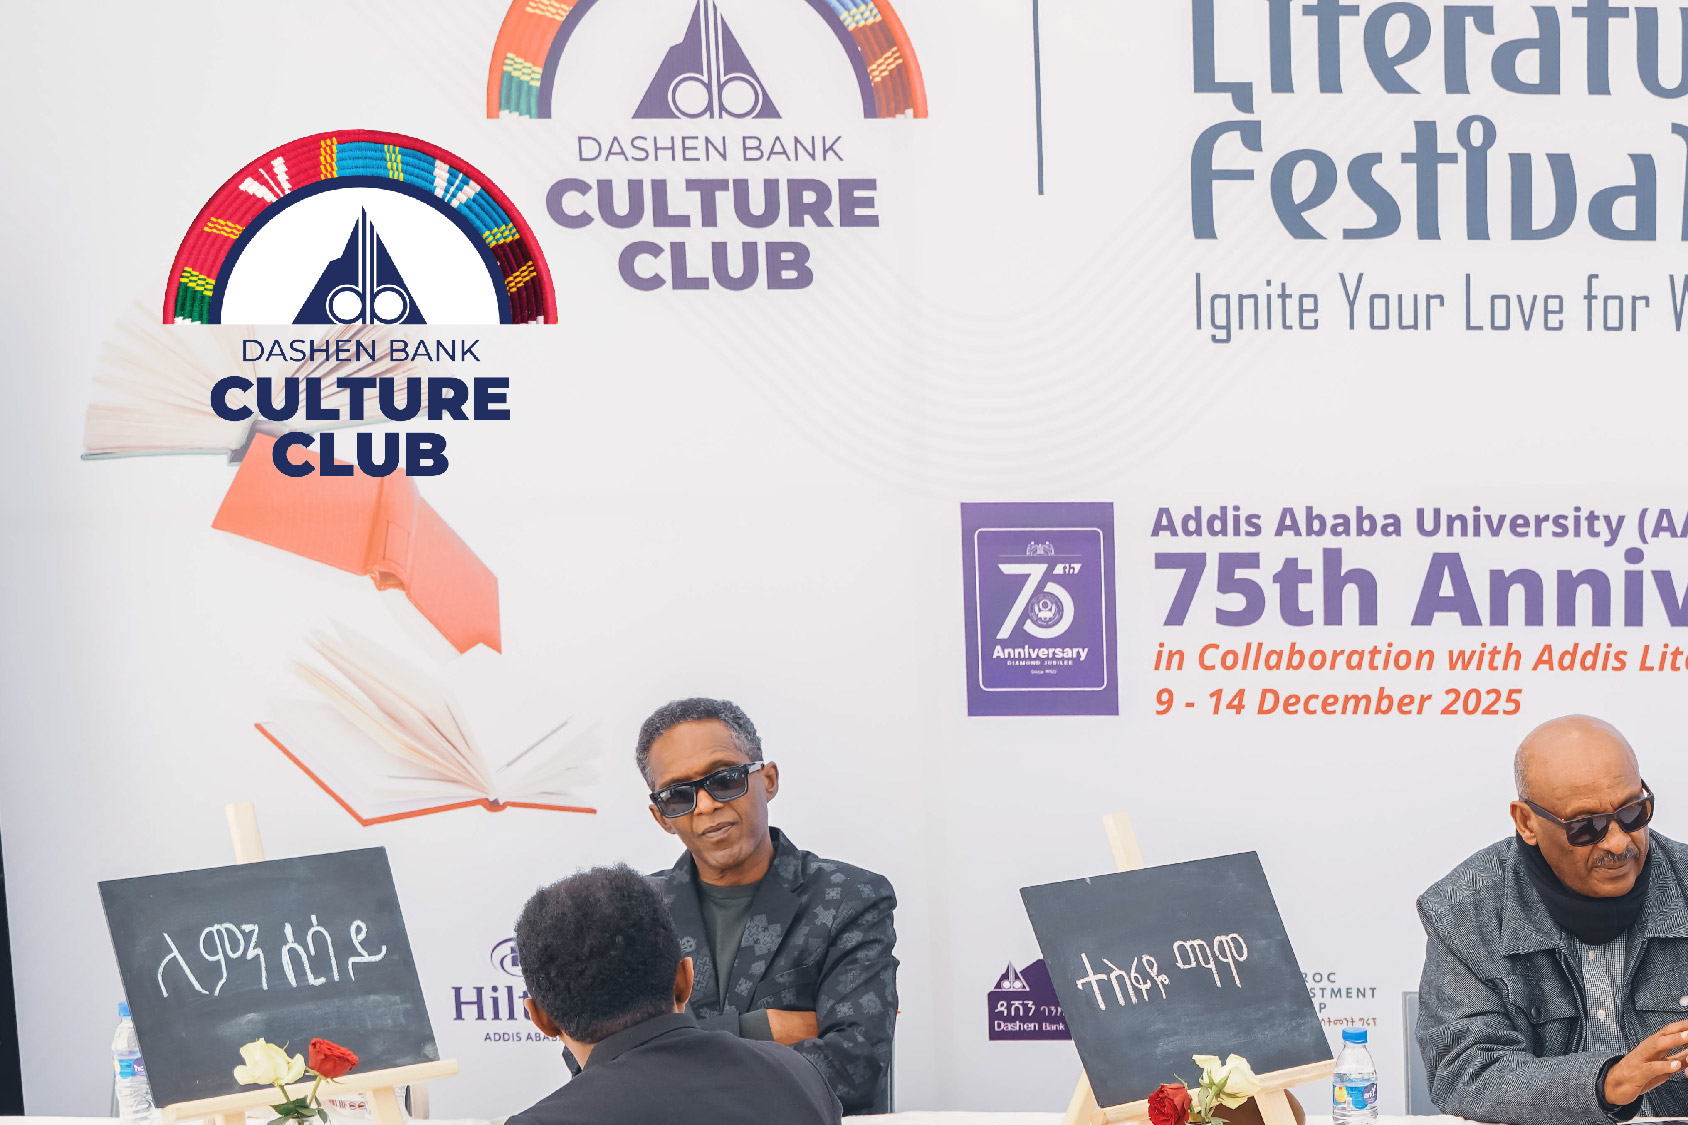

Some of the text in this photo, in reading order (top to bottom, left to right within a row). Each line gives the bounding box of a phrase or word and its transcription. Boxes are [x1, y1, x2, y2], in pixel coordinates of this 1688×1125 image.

[578, 136, 843, 161] DASHEN BANK
[546, 178, 879, 229] CULTURE
[618, 241, 813, 291] CLUB
[1196, 273, 1318, 343] Ignite
[1339, 273, 1444, 330] Your
[1466, 273, 1563, 331] Love
[1584, 274, 1649, 331] for
[1149, 502, 1267, 542] Addis
[1276, 502, 1403, 542] Ababa
[1415, 504, 1629, 551] University
[1151, 547, 1380, 630] 75th
[992, 644, 1089, 661] Anniversary
[1153, 640, 1187, 671] in
[1195, 638, 1438, 672] Collaboration
[1446, 638, 1524, 672] with
[1530, 638, 1630, 672] Addis
[1153, 684, 1176, 715] 9
[1207, 684, 1248, 715] 14
[1259, 683, 1434, 717] December
[1442, 684, 1524, 717] 2025
[452, 985, 531, 1021] Hilt
[1310, 988, 1376, 998] STMENT
[484, 1032, 522, 1042] ADDIS
[994, 1021, 1065, 1031] Dashen Bank
